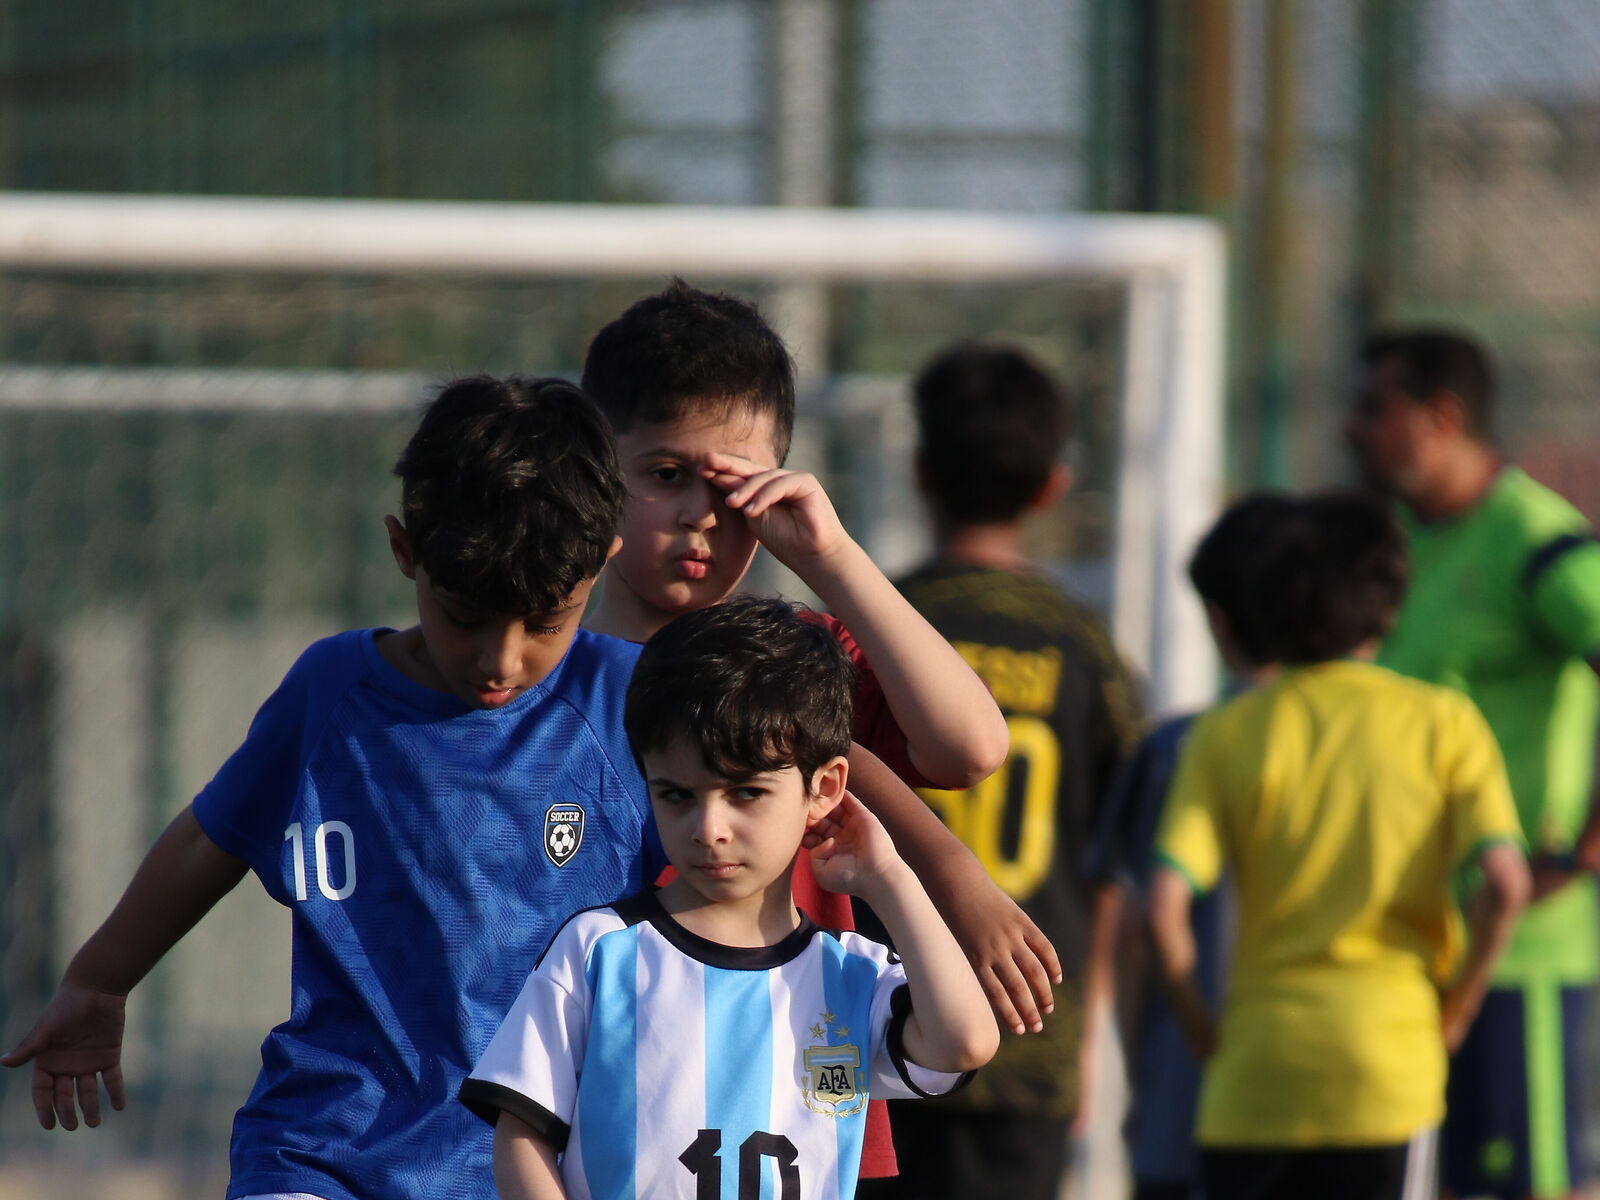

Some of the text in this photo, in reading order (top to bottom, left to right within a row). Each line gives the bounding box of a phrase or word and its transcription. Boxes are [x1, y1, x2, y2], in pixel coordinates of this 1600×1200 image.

[550, 811, 580, 822] SOCCER
[284, 820, 356, 900] 10
[817, 1064, 852, 1096] AFA
